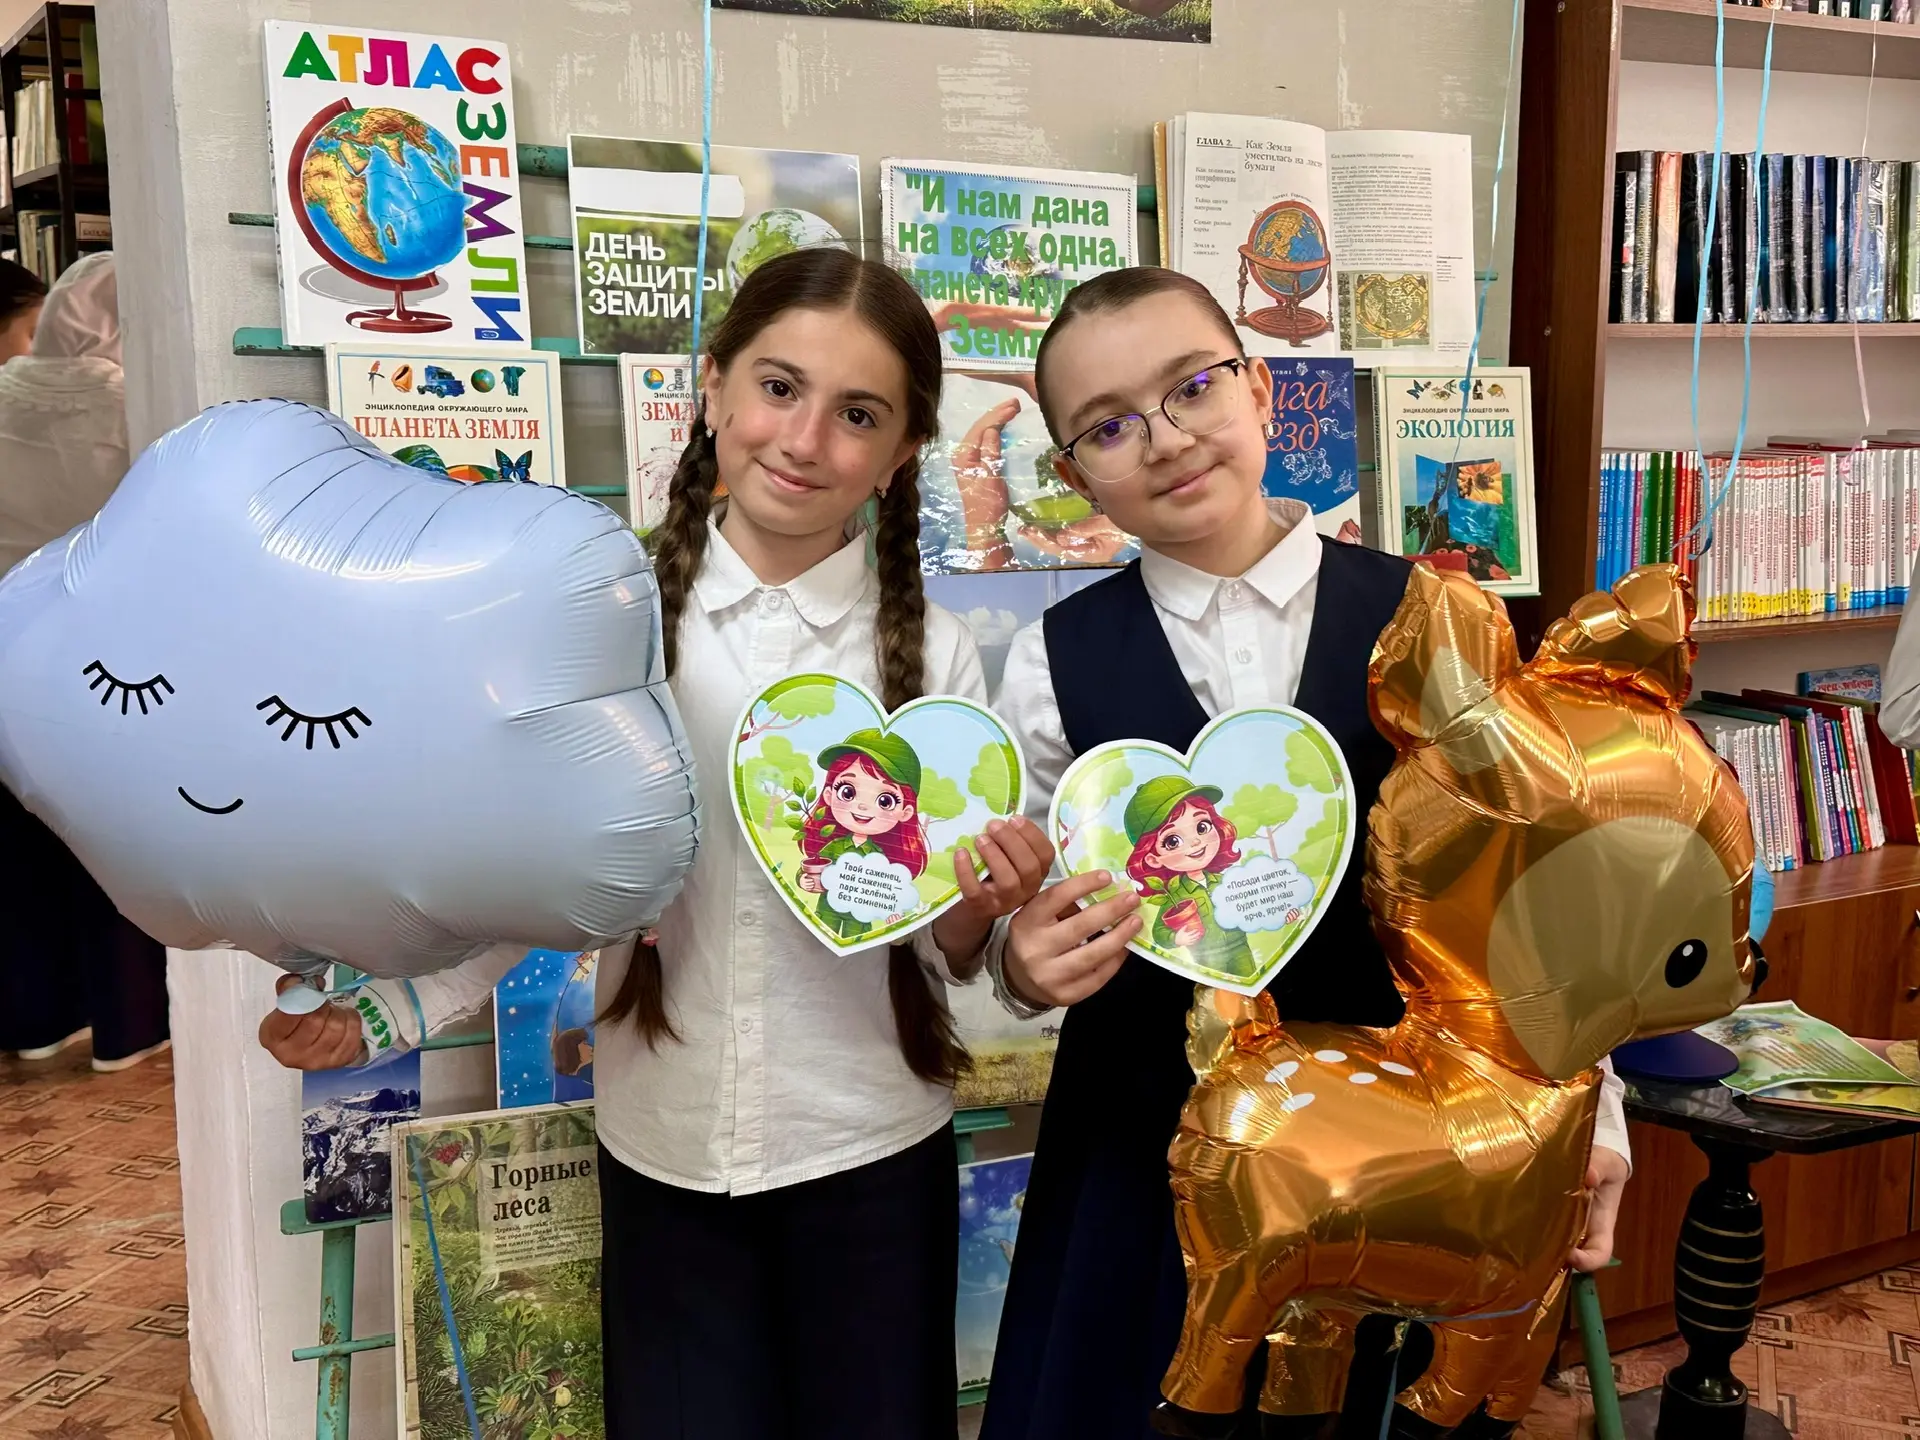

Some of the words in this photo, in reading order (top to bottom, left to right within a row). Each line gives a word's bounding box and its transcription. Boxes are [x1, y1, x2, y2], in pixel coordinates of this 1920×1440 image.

[282, 31, 504, 95] АТЛАС
[1196, 137, 1224, 146] ГЛАВА
[1246, 139, 1263, 149] Как
[1266, 141, 1292, 153] Земля
[1244, 151, 1293, 164] уместилась
[1244, 160, 1276, 172] бумаги
[456, 97, 525, 342] ЗЕМЛИ
[957, 188, 1022, 220] нам
[1031, 195, 1109, 229] дана
[585, 231, 666, 262] ДЕНЬ
[898, 222, 940, 255] на
[951, 226, 1030, 262] всех
[1039, 232, 1126, 272] одна,
[586, 260, 724, 293] ЗАЩИТЫ
[588, 288, 691, 319] ЗЕМЛИ
[948, 314, 1042, 359] Земл
[1271, 381, 1329, 410] ига
[365, 403, 435, 412] ЭНЦИКЛОПЕДИЯ
[437, 405, 503, 413] ОКРУЖАЮЩЕГО
[505, 406, 529, 414] МИРА
[641, 401, 696, 421] ЗЕМЛ
[353, 416, 462, 439] ПЛАНЕТА
[465, 418, 541, 440] ЗЕМЛЯ
[1265, 410, 1320, 452] ёзд
[1395, 418, 1515, 439] ЭКОЛОГИЯ
[839, 873, 856, 883] мой
[857, 877, 892, 892] саженец
[844, 861, 863, 874] Твой
[865, 867, 902, 883] саженец,
[1261, 868, 1291, 883] цветок,
[837, 891, 852, 902] без
[853, 895, 896, 912] сомненья!
[838, 882, 859, 894] парк
[860, 887, 898, 903] зелёный,
[1225, 888, 1260, 903] покорми
[1260, 881, 1287, 895] птичку
[1236, 900, 1259, 912] будет
[1260, 894, 1276, 906] мир
[1277, 891, 1294, 901] наш
[1244, 912, 1266, 923] ярче,
[490, 1158, 591, 1190] Горные
[493, 1194, 551, 1221] леса
